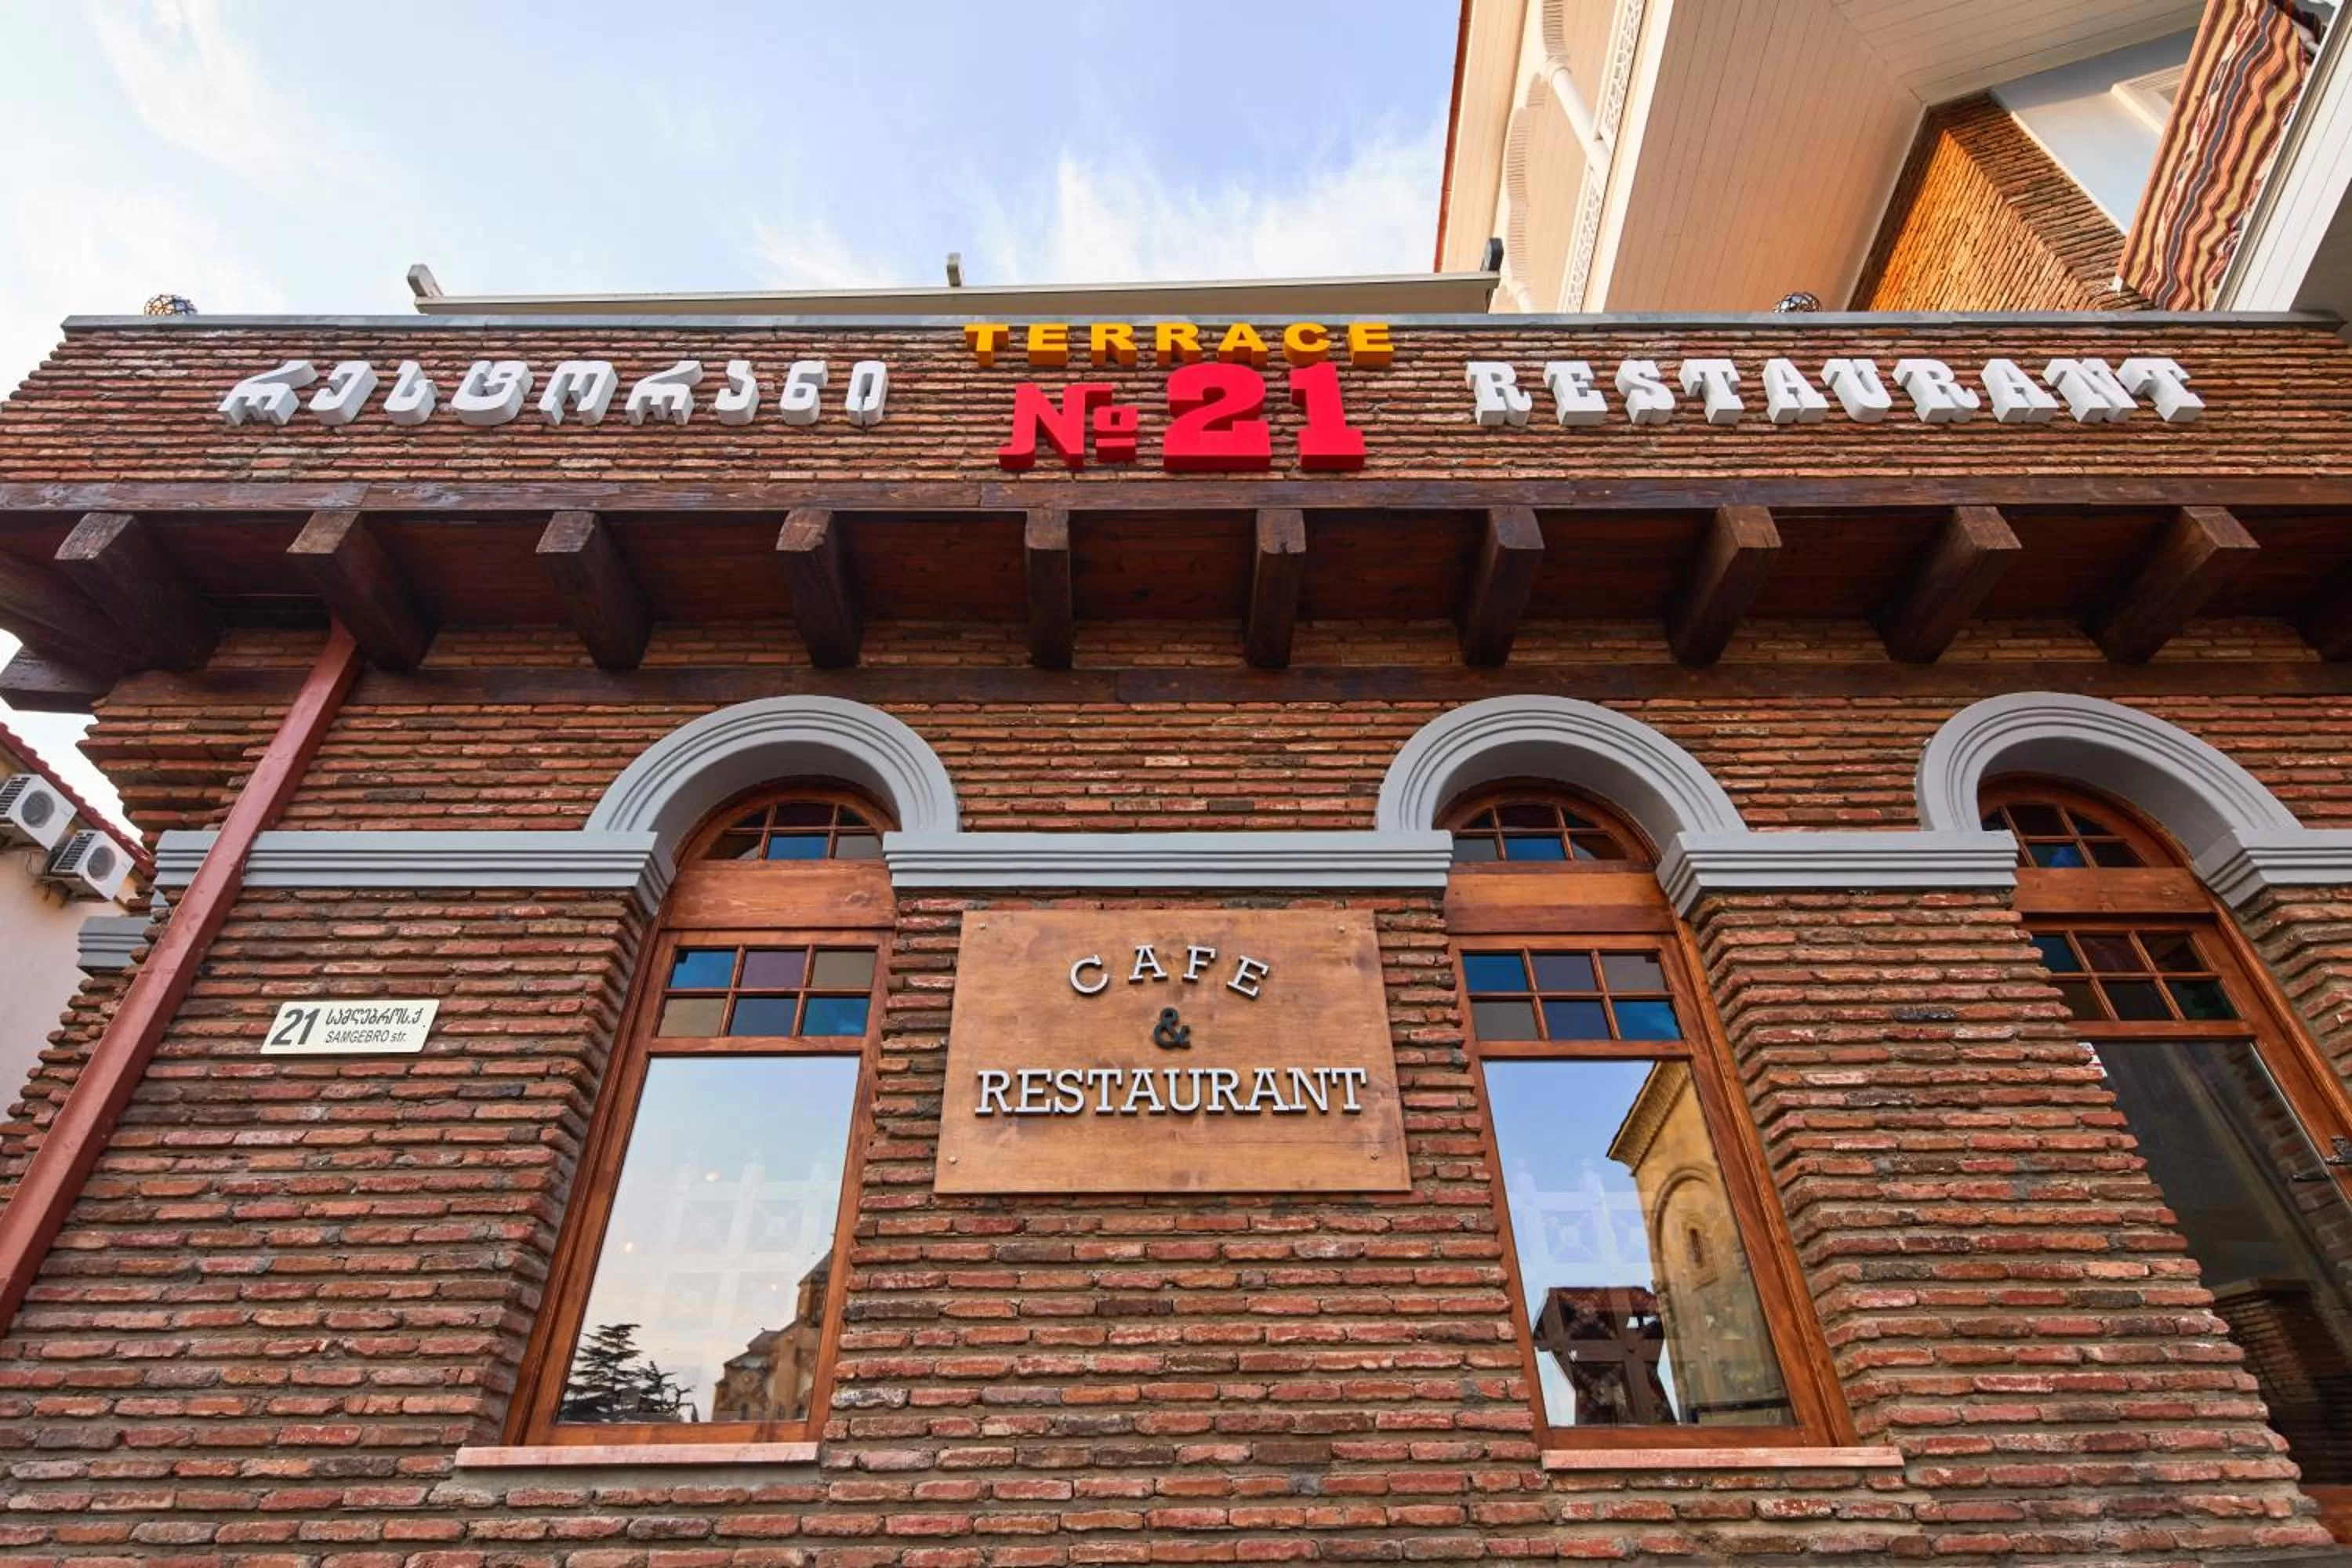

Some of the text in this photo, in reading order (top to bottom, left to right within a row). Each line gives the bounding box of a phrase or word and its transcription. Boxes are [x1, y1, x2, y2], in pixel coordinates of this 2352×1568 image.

[964, 322, 1395, 367] TERRACE
[218, 358, 888, 426] რესტორანი
[1163, 362, 1363, 470] 21
[1465, 358, 2205, 426] RESTAURANT
[1069, 944, 1269, 999] CAFE
[271, 1008, 320, 1045] 21
[325, 1029, 390, 1044] SAMGEBRO
[1153, 1007, 1191, 1050] &
[975, 1066, 1367, 1116] RESTAURANT
